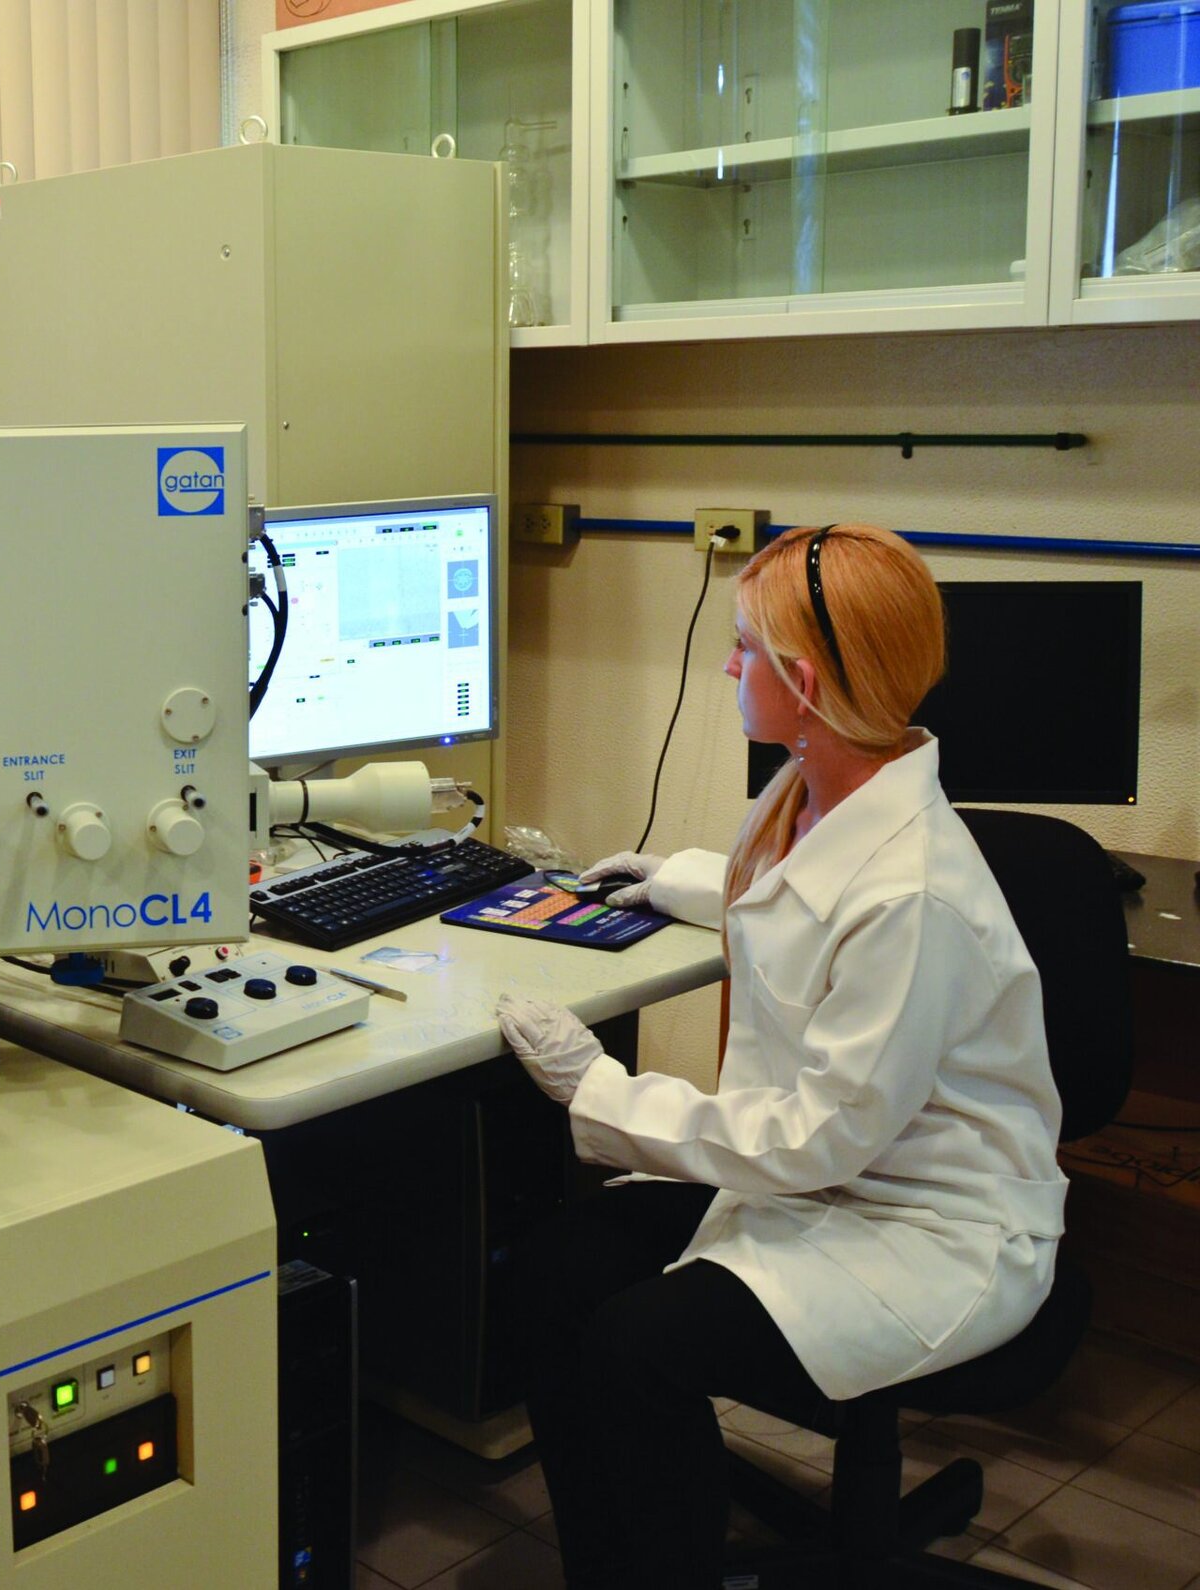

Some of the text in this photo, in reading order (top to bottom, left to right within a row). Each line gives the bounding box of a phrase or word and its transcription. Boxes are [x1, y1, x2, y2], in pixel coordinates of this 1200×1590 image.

[164, 471, 225, 493] gatan
[2, 753, 65, 767] ENTRANCE
[173, 748, 197, 760] EXIT
[24, 769, 45, 781] SLIT
[174, 763, 195, 775] SLIT
[26, 891, 213, 933] MonoCL4
